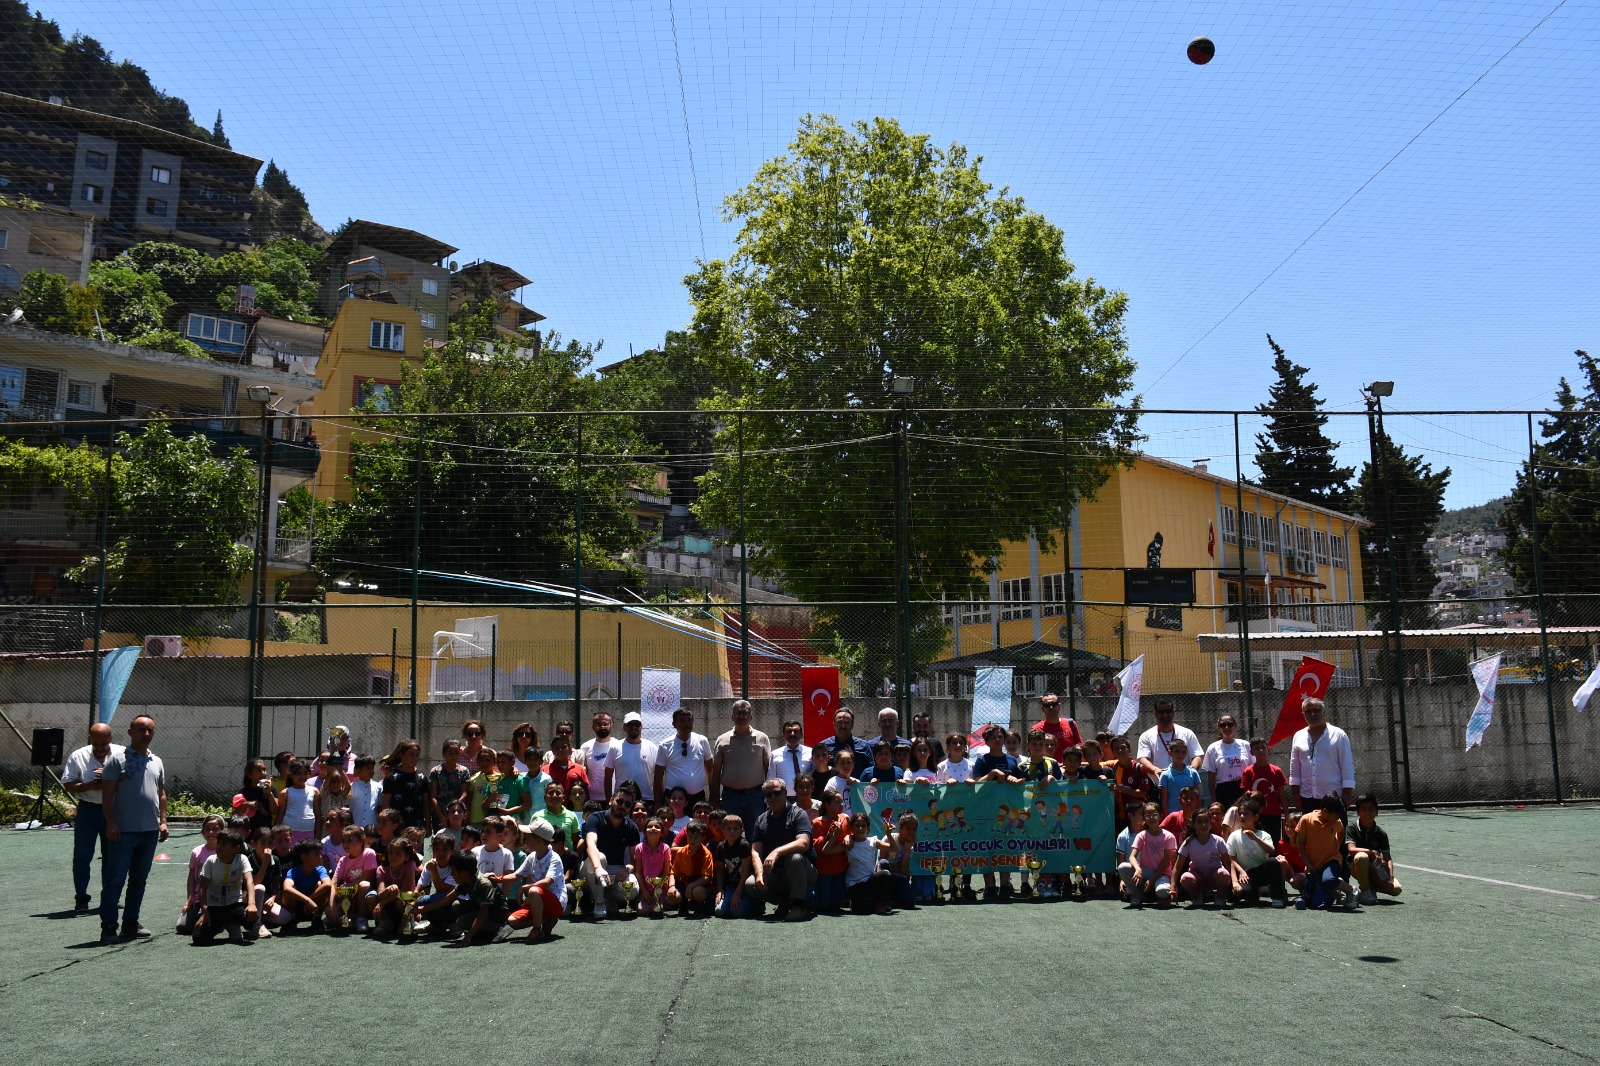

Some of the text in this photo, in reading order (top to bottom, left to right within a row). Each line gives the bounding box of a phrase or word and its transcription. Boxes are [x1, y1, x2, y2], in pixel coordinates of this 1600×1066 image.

[960, 838, 1004, 856] ÇOCUK
[1073, 837, 1092, 851] VE
[950, 855, 989, 869] OYUN
